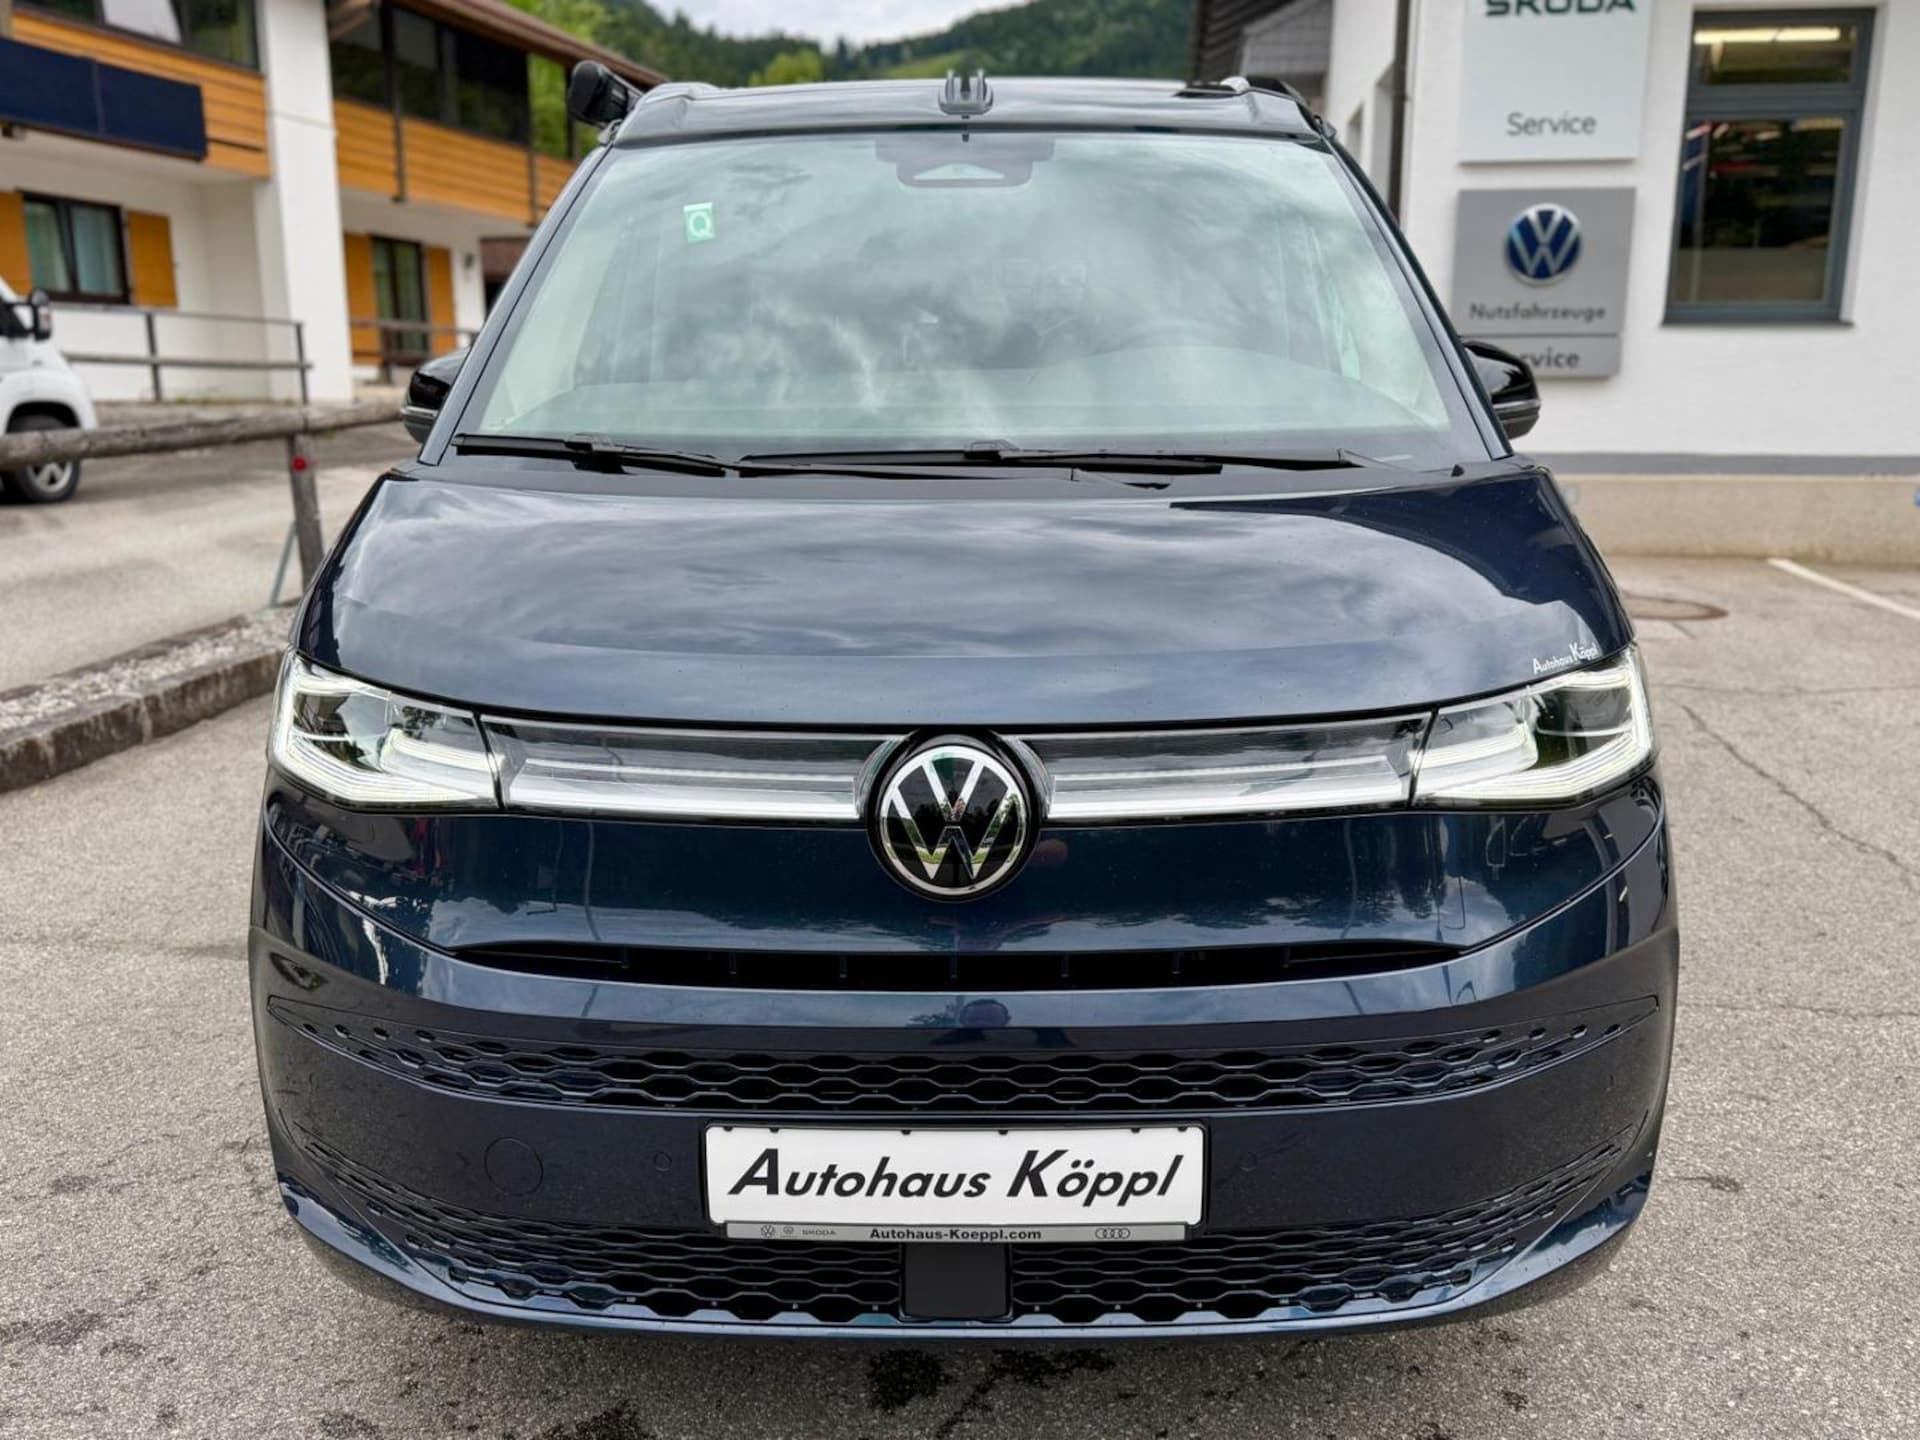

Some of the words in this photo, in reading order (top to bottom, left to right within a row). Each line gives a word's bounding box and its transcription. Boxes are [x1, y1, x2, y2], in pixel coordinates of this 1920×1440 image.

[1506, 111, 1597, 137] Service
[1468, 302, 1606, 324] Nutzfahrzeuge
[727, 1147, 992, 1198] Autohaus
[1006, 1149, 1185, 1207] Köppl
[869, 1227, 1042, 1242] Autohaus-Koeppl.com
